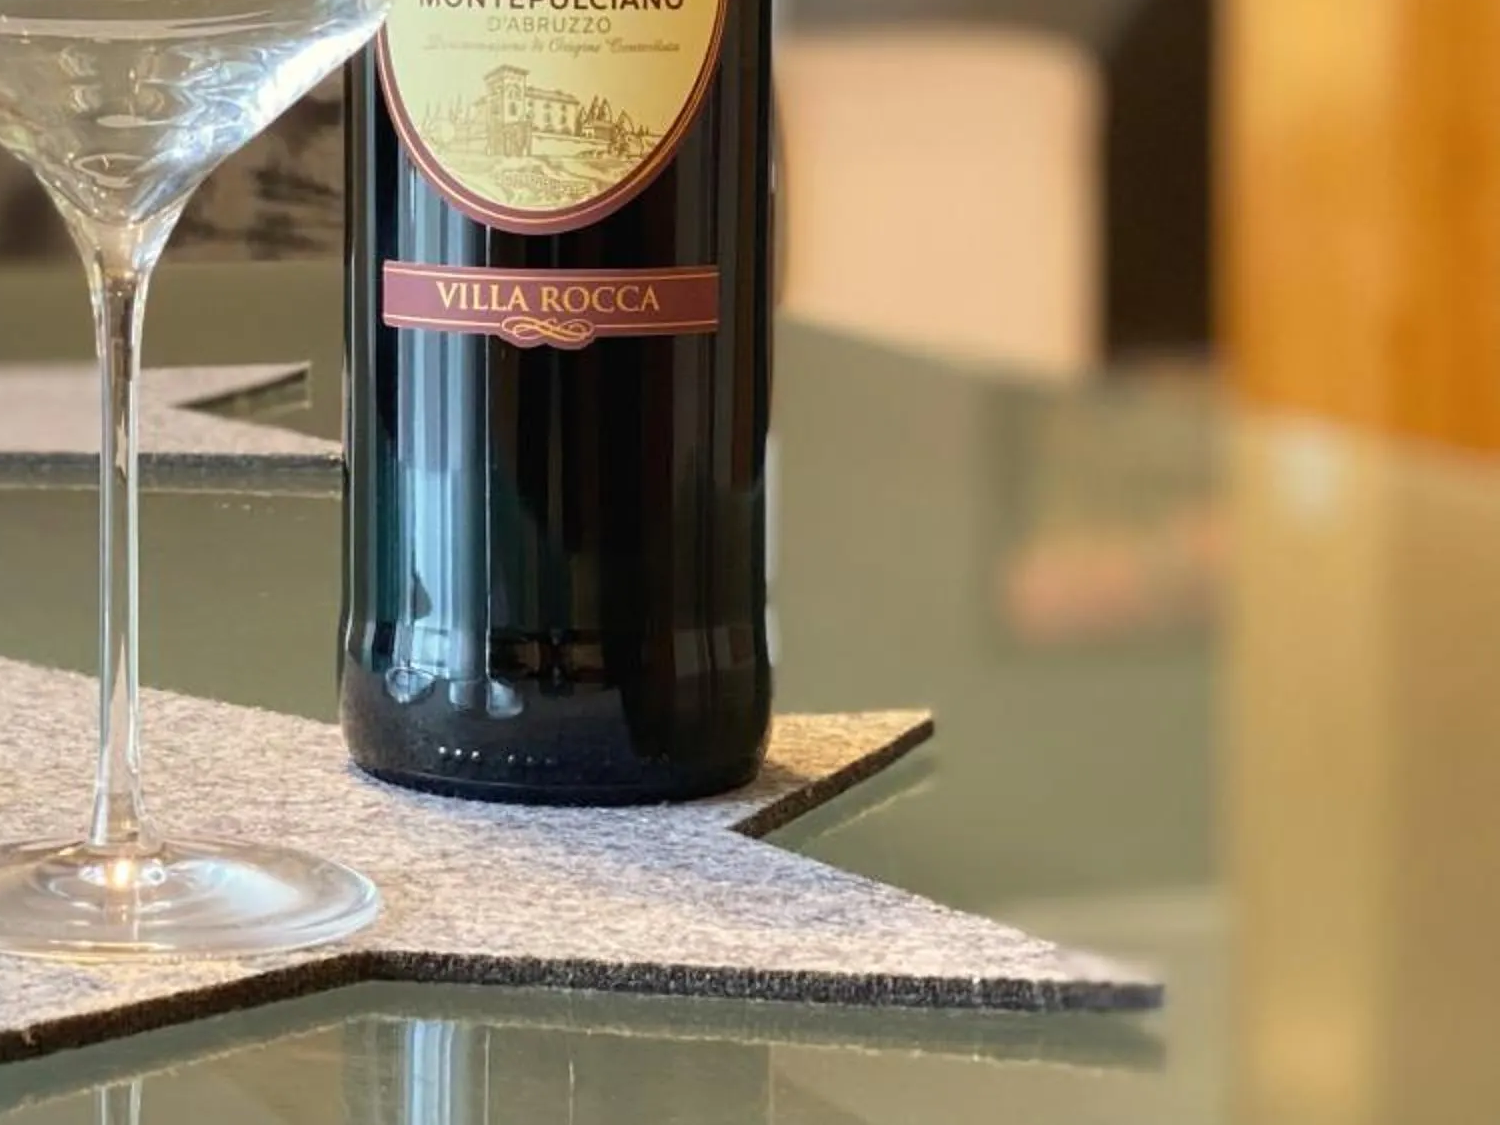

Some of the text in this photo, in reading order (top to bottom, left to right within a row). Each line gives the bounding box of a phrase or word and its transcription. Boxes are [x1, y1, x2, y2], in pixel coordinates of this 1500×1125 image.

[486, 15, 612, 33] D'ABRUZZO
[435, 281, 661, 313] VILLA ROCCA
